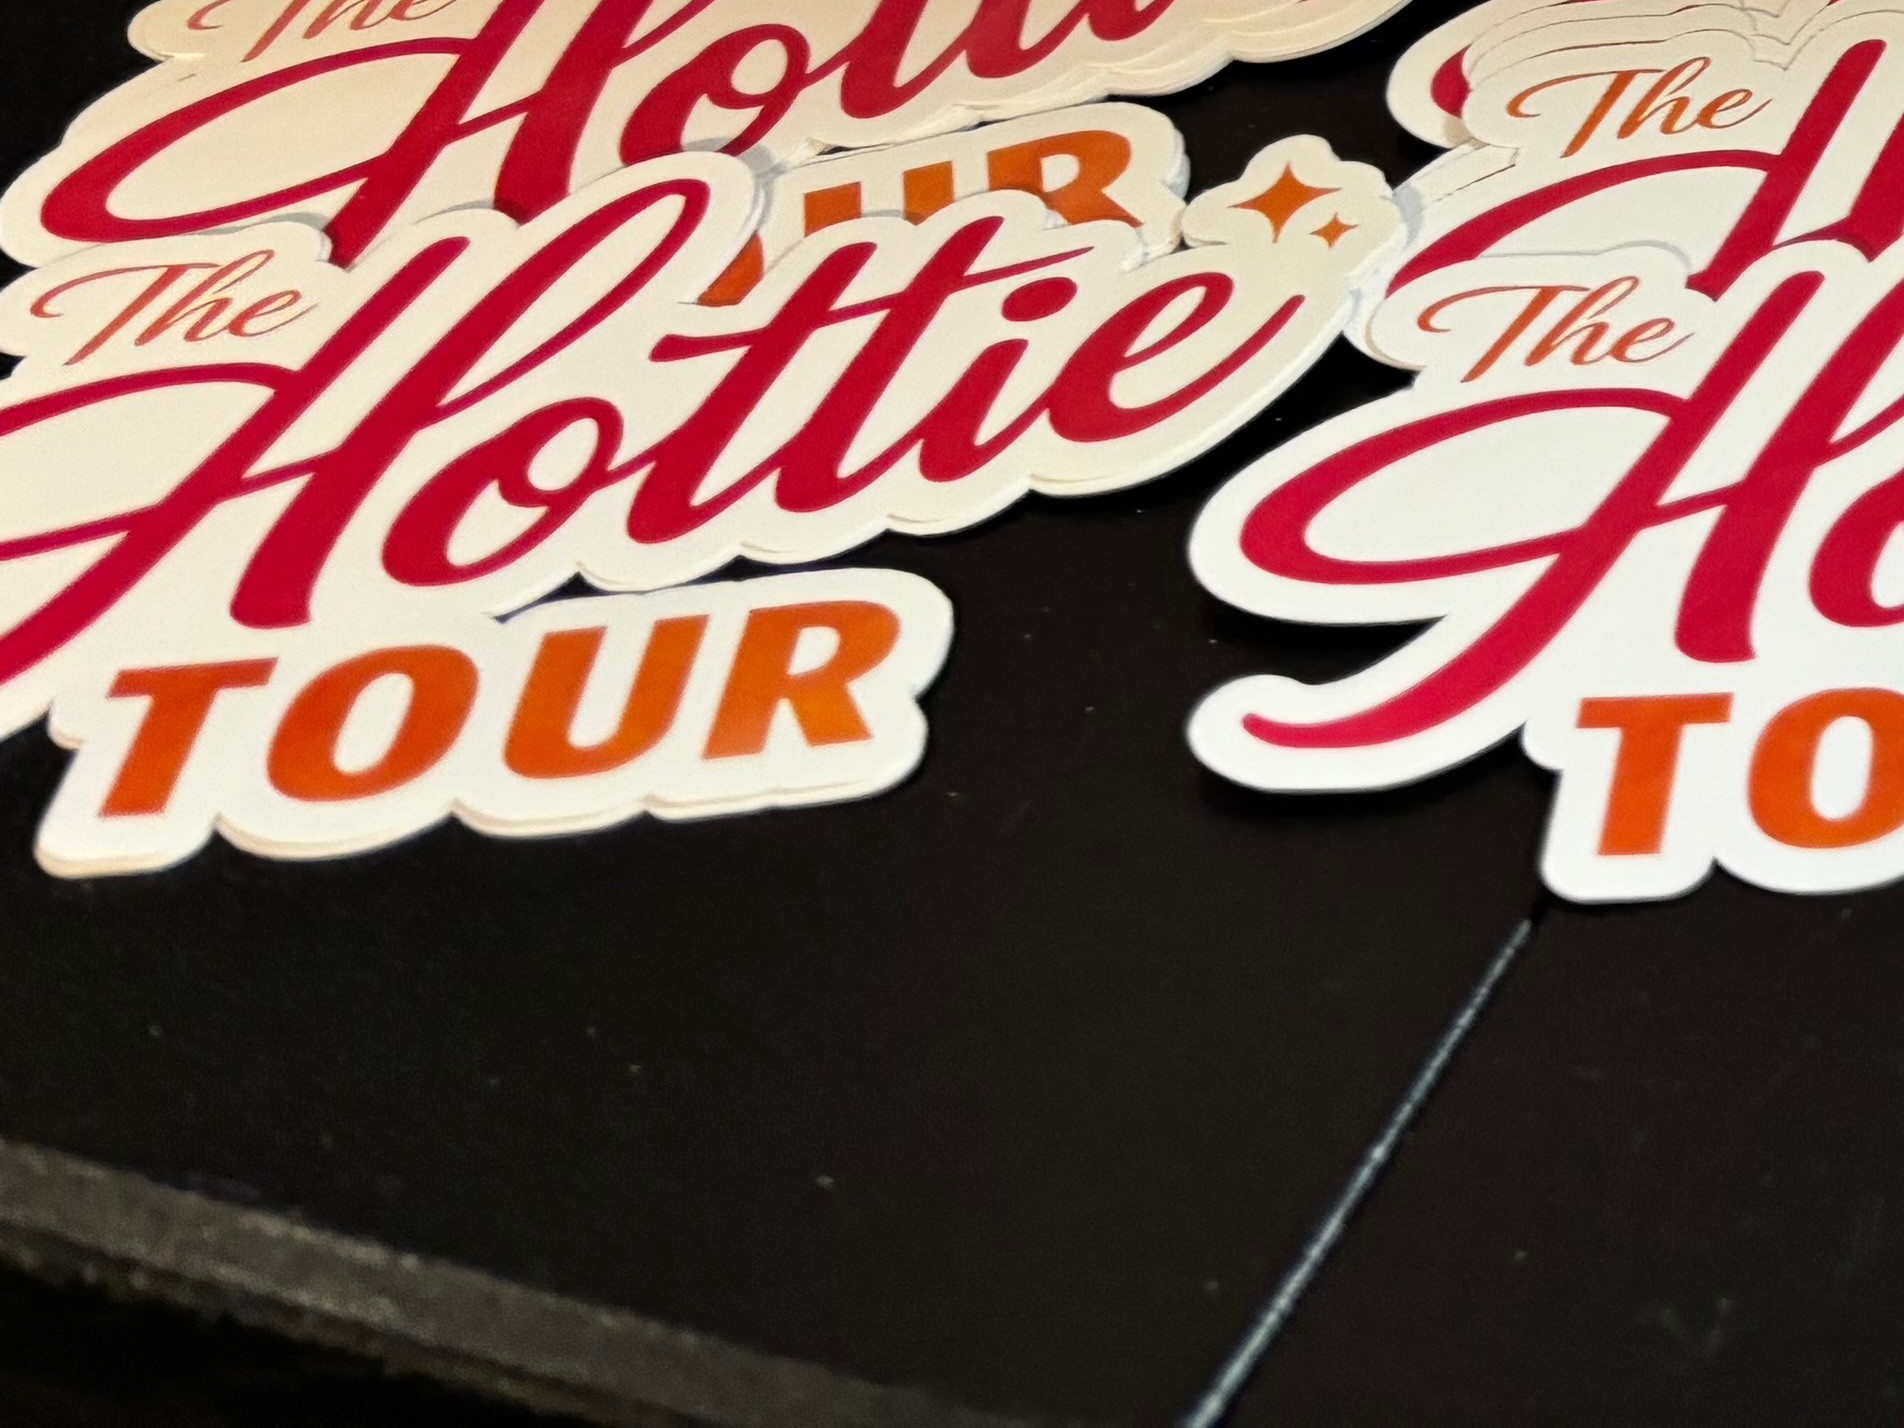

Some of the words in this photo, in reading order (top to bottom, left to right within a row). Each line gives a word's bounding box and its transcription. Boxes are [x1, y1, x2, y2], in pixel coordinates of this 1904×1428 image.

[1506, 56, 1772, 159] The
[30, 248, 318, 366] The
[1418, 274, 1696, 384] The
[0, 177, 1305, 689] Hottie
[98, 597, 902, 818] TOUR
